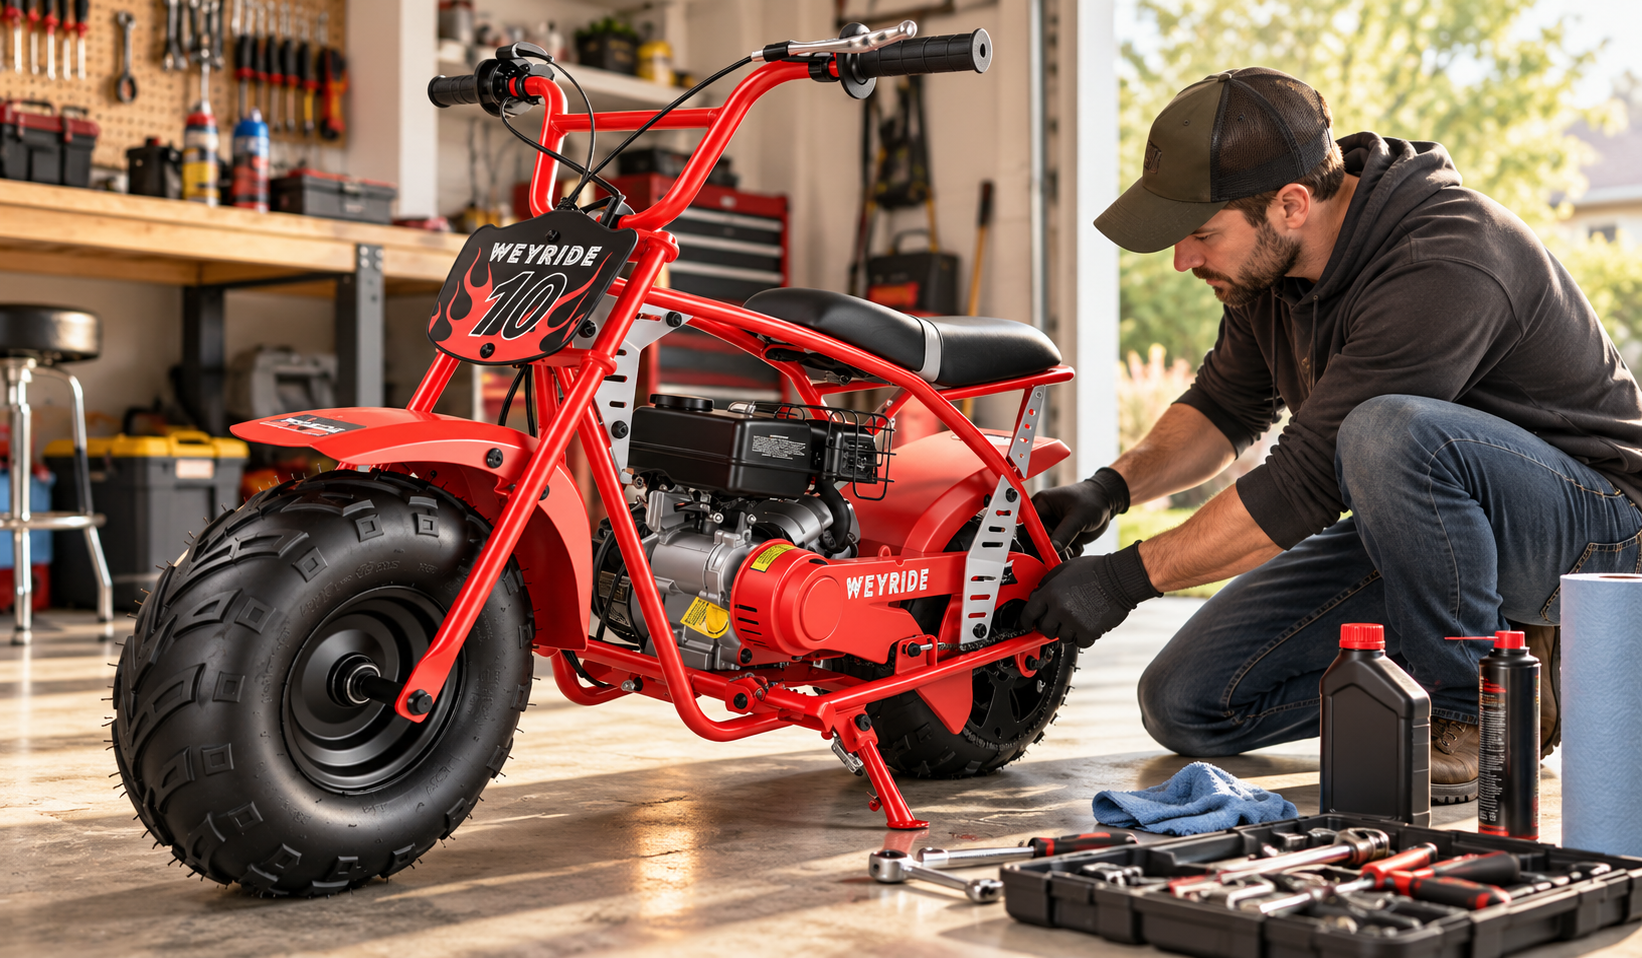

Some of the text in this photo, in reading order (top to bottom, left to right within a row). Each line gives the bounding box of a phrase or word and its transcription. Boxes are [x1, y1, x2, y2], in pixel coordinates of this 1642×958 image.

[489, 242, 602, 267] WEYRIDE
[468, 271, 567, 340] 10
[846, 568, 929, 600] WEYRIDE
